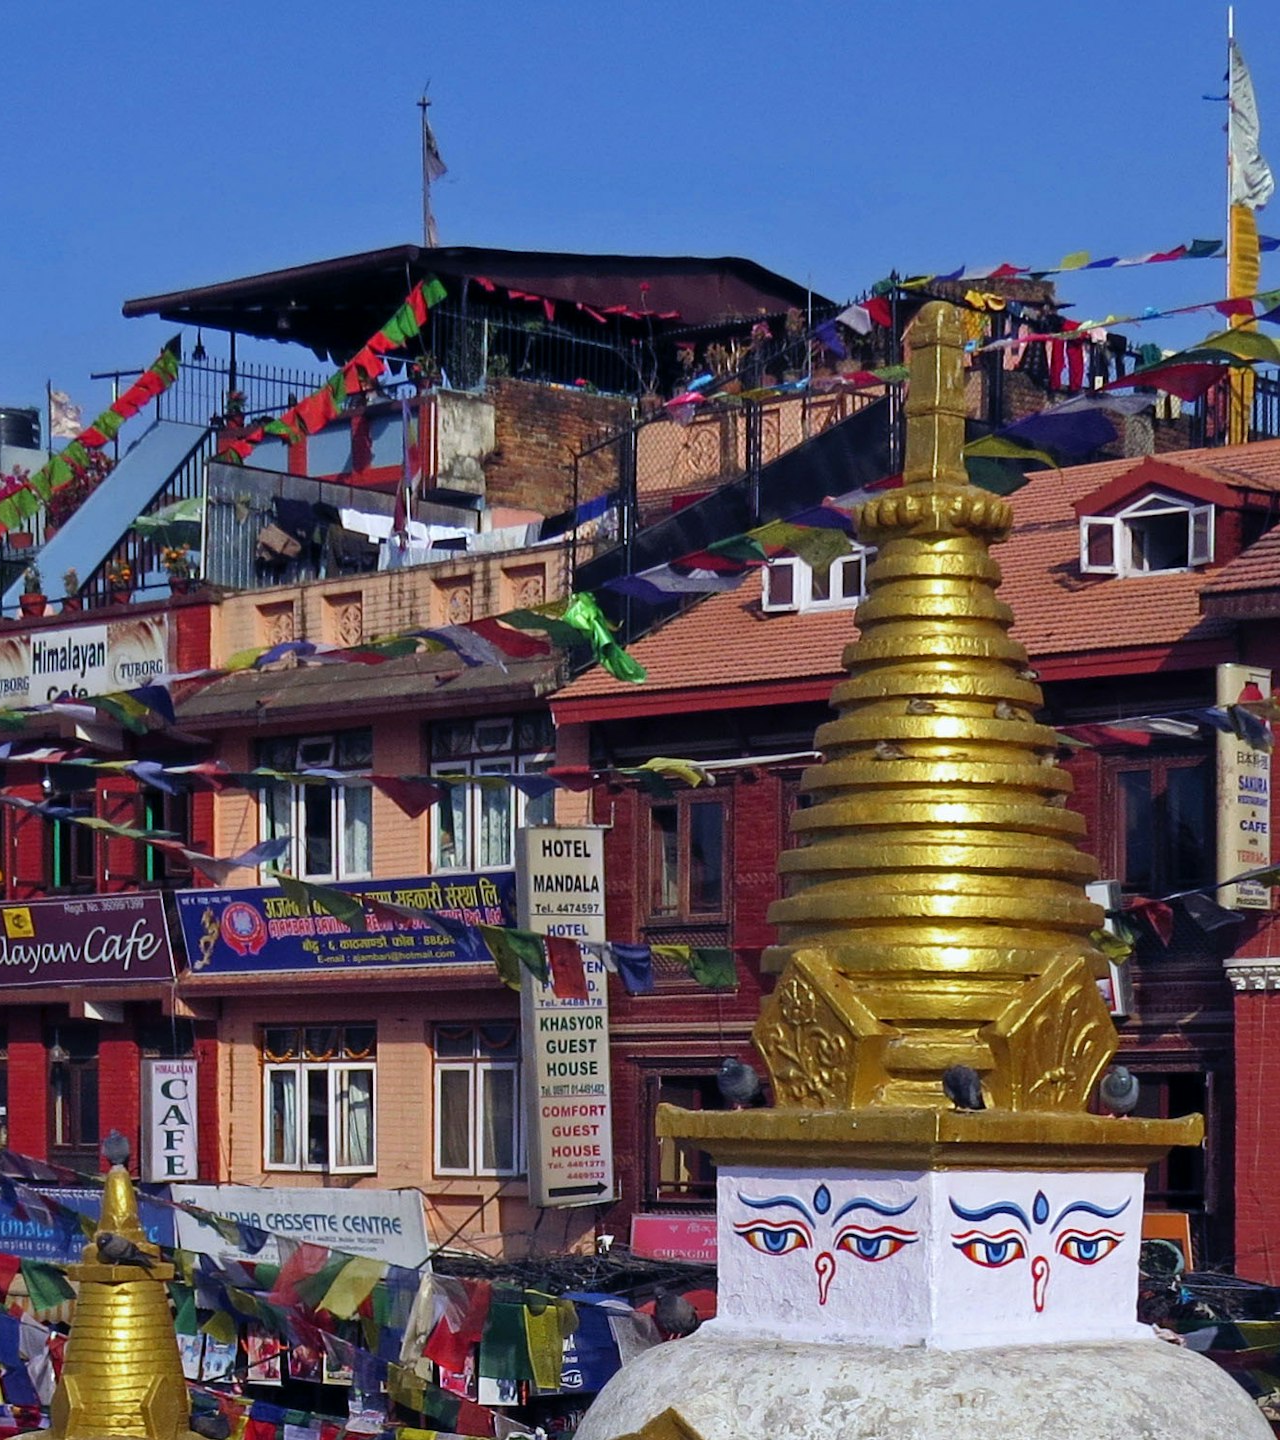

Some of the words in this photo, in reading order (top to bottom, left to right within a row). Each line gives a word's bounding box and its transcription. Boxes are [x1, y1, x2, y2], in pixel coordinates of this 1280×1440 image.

[32, 637, 106, 679] Himalayan
[120, 659, 163, 679] TUBORG
[1238, 775, 1268, 794] SAKURA
[1239, 820, 1268, 834] CAFE
[542, 839, 592, 858] HOTEL
[533, 874, 600, 894] MANDALA
[535, 903, 554, 914] Tel.
[557, 903, 600, 914] 4474597
[547, 924, 590, 937] HOTEL
[82, 917, 163, 971] Cafe
[539, 1015, 604, 1032] KHASYOR
[545, 1038, 597, 1054] GUEST
[154, 1063, 194, 1075] HIMALAYAN
[546, 1060, 599, 1077] HOUSE
[541, 1105, 607, 1118] COMFORT
[158, 1078, 190, 1177] CAFE
[551, 1125, 600, 1138] GUEST
[551, 1144, 601, 1158] HOUSE
[265, 1213, 338, 1233] CASSETTE
[342, 1215, 403, 1235] CENTRE
